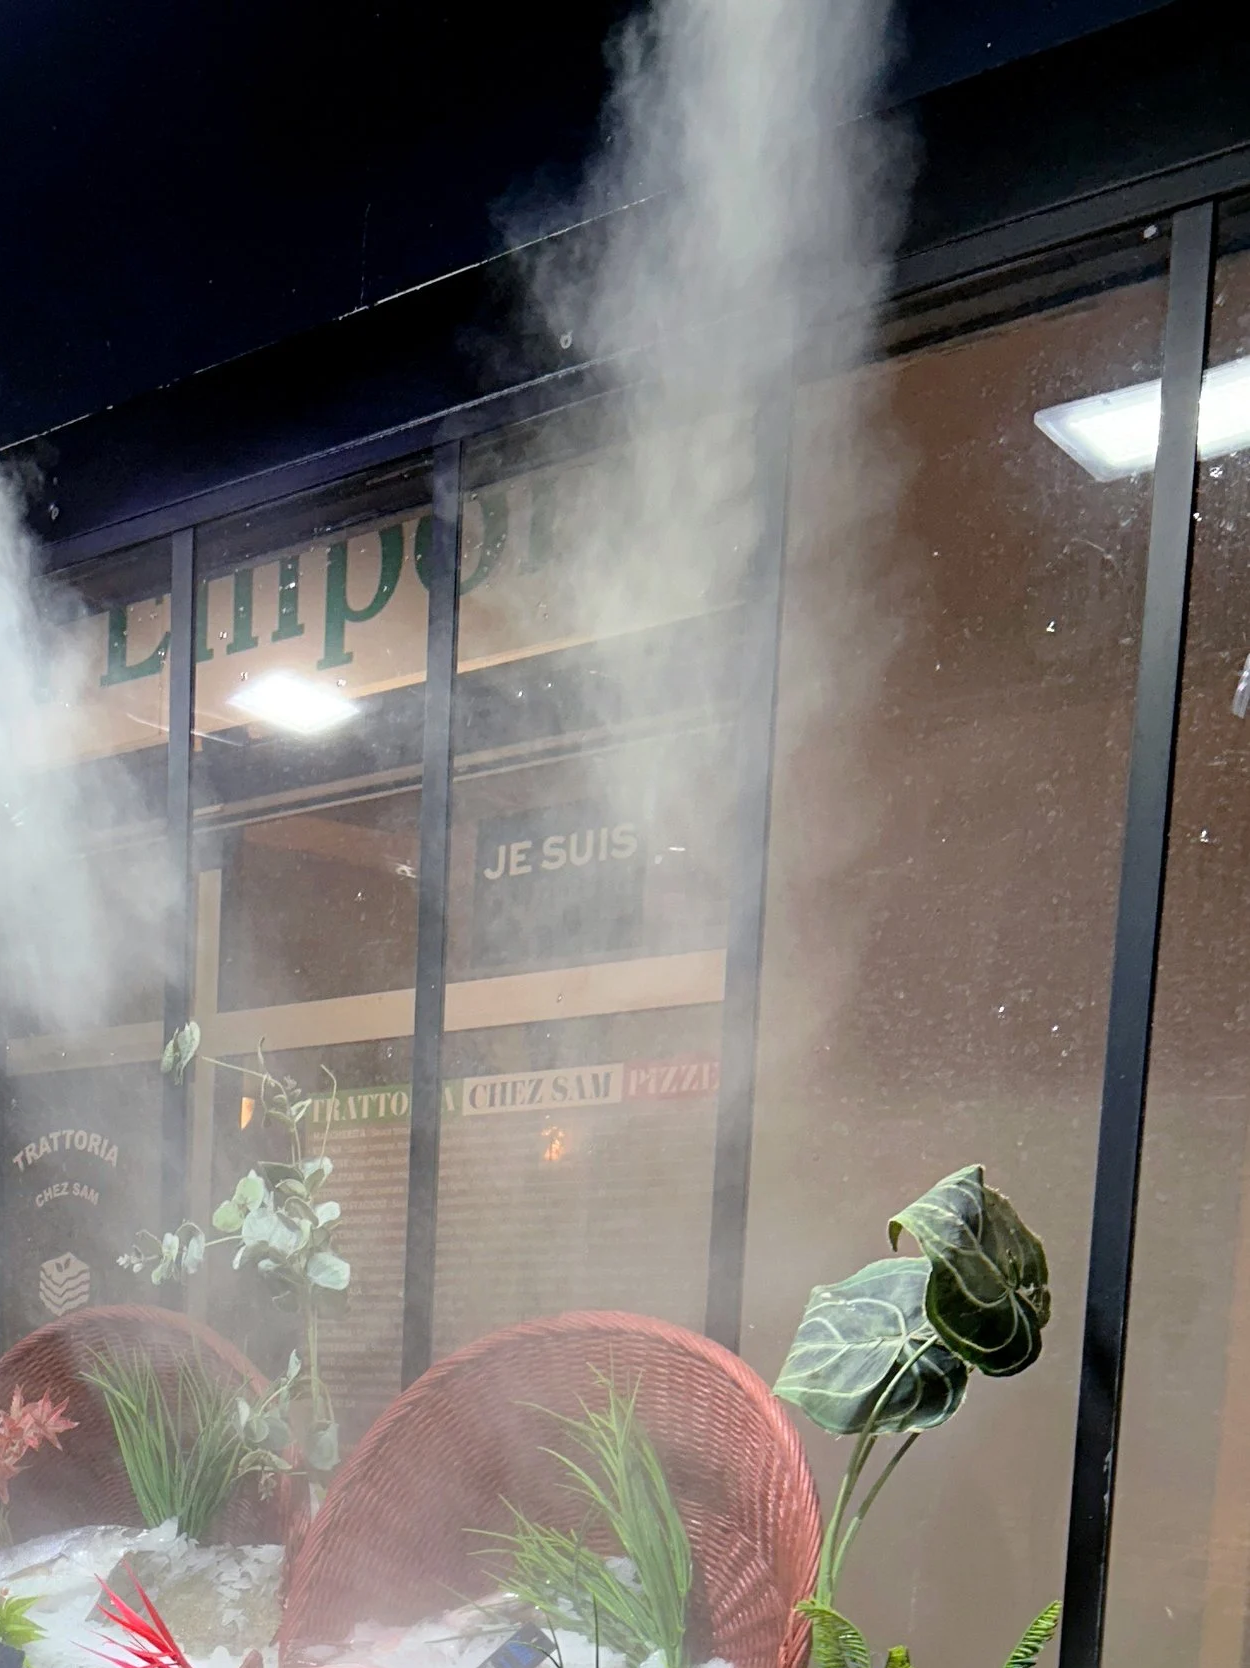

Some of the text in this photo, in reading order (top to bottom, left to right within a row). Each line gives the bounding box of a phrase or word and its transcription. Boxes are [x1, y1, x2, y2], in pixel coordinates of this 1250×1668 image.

[482, 821, 639, 881] JE SUIS
[468, 1077, 546, 1110] CHEZ
[551, 1070, 614, 1101] SAM
[12, 1129, 119, 1173] TRATTORIA
[34, 1181, 100, 1208] CHEZ SAM
